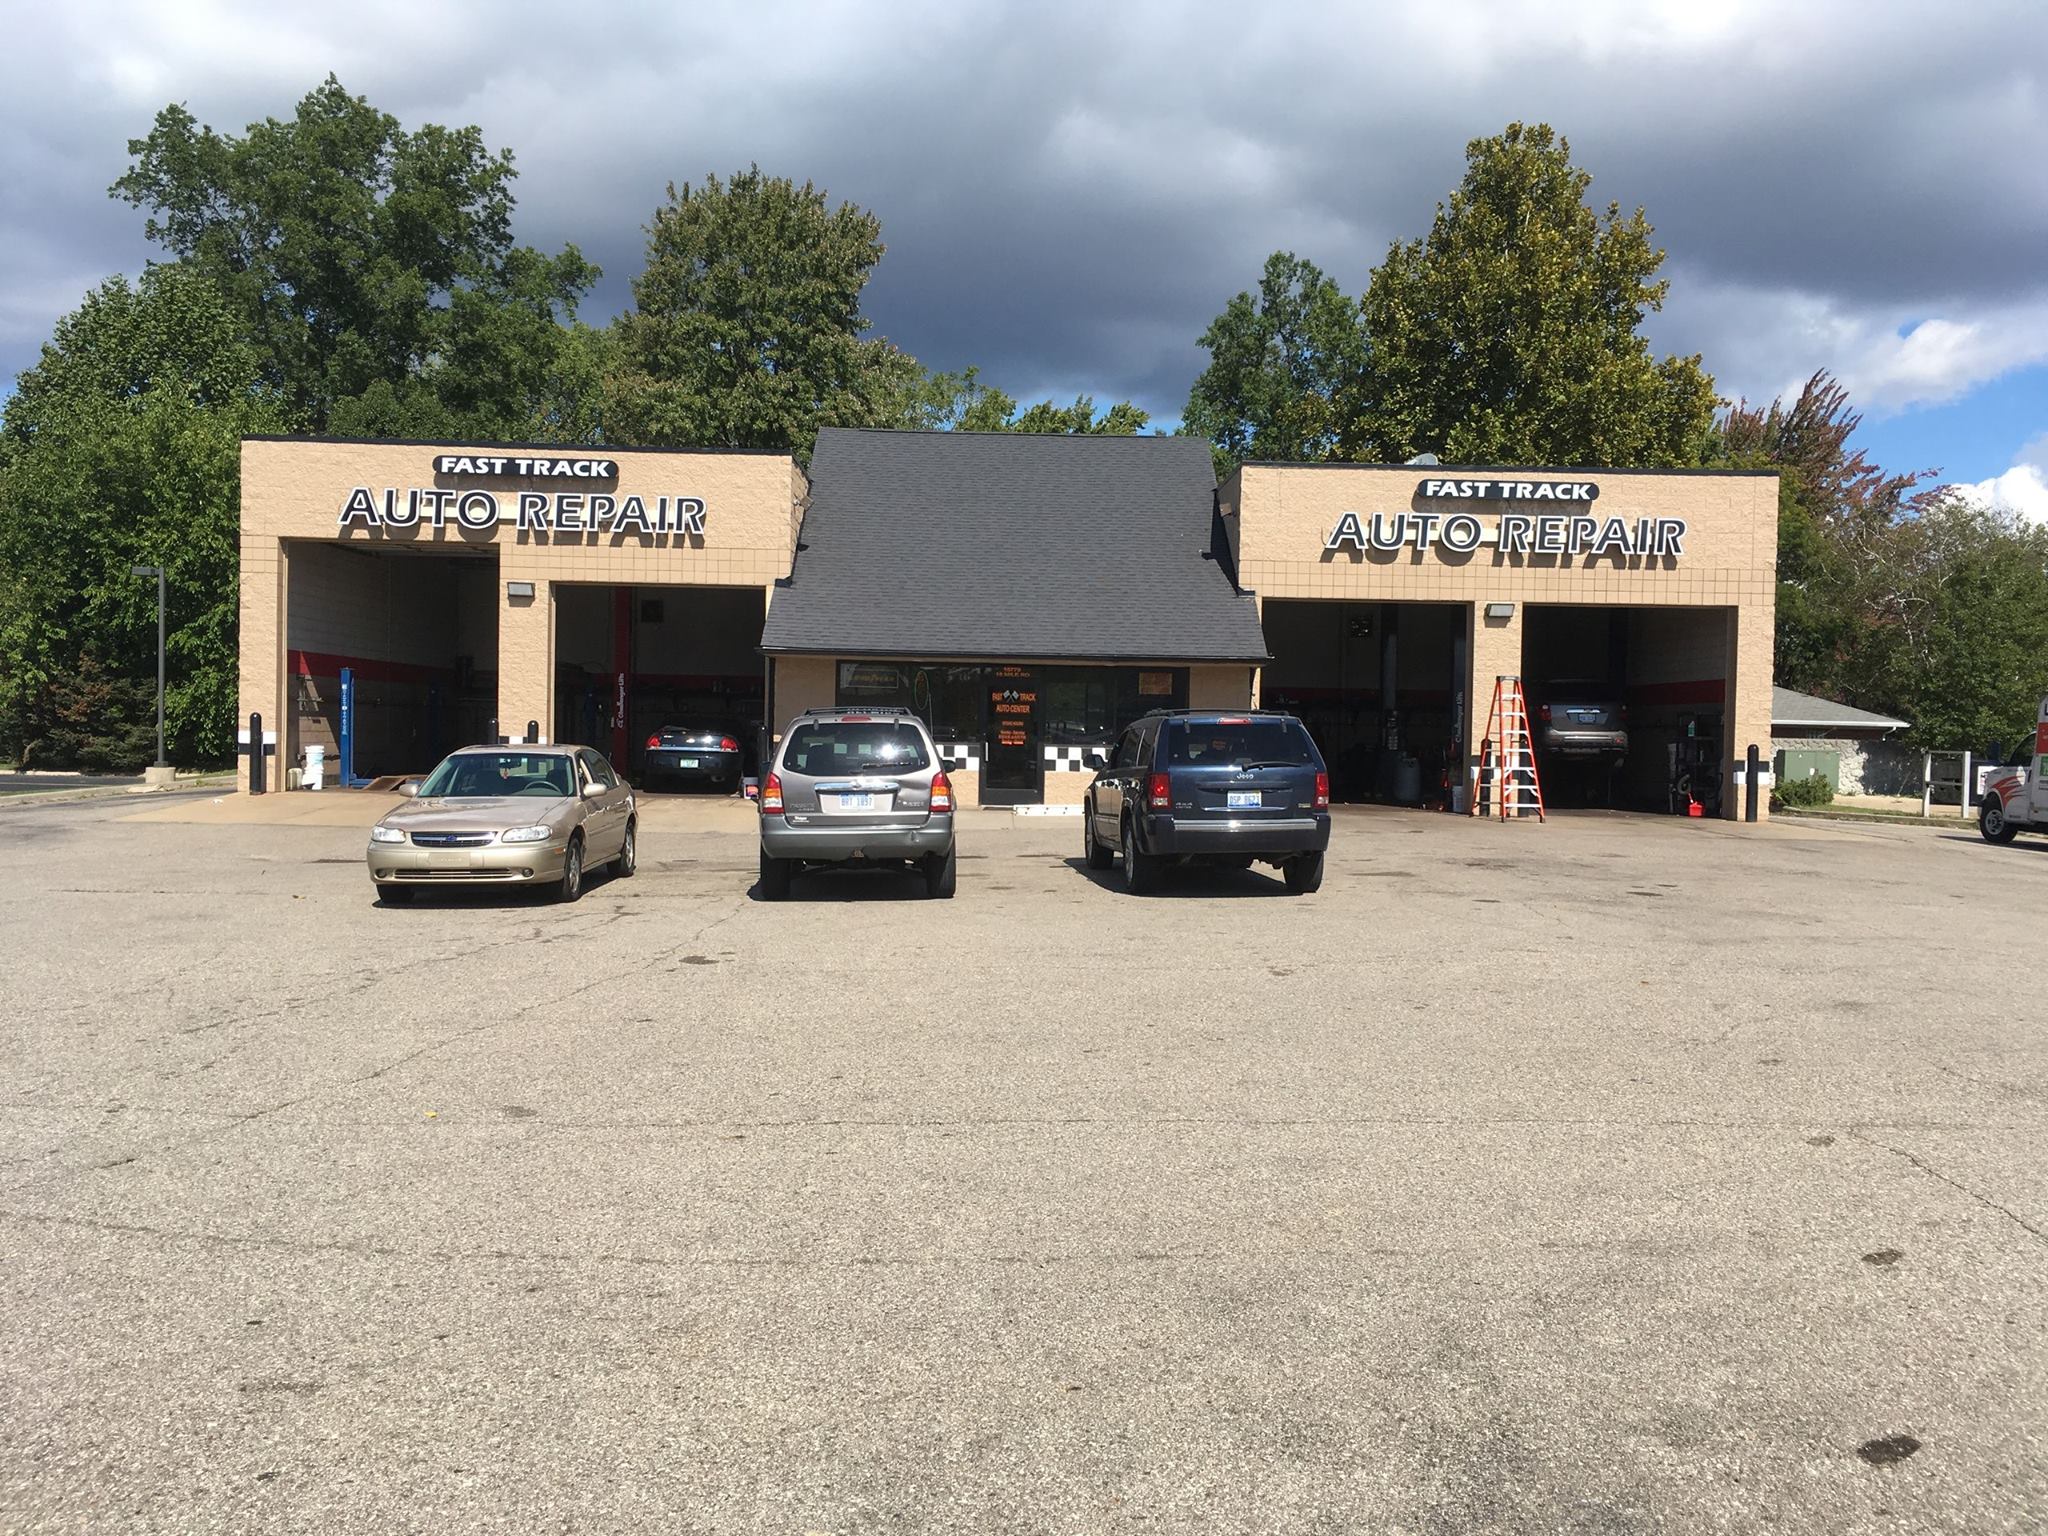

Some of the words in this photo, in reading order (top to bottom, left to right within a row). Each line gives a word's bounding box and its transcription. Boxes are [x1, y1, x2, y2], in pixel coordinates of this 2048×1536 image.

[440, 456, 507, 475] FAST
[514, 458, 610, 478] TRACK
[1426, 481, 1491, 498] FAST
[1497, 482, 1591, 501] TRACK
[338, 487, 501, 530] AUTO
[516, 491, 706, 534] REPAIR
[1325, 512, 1483, 553] AUTO
[1498, 514, 1687, 556] REPAIR
[1020, 693, 1036, 702] TRACK
[1236, 772, 1254, 780] Jeep
